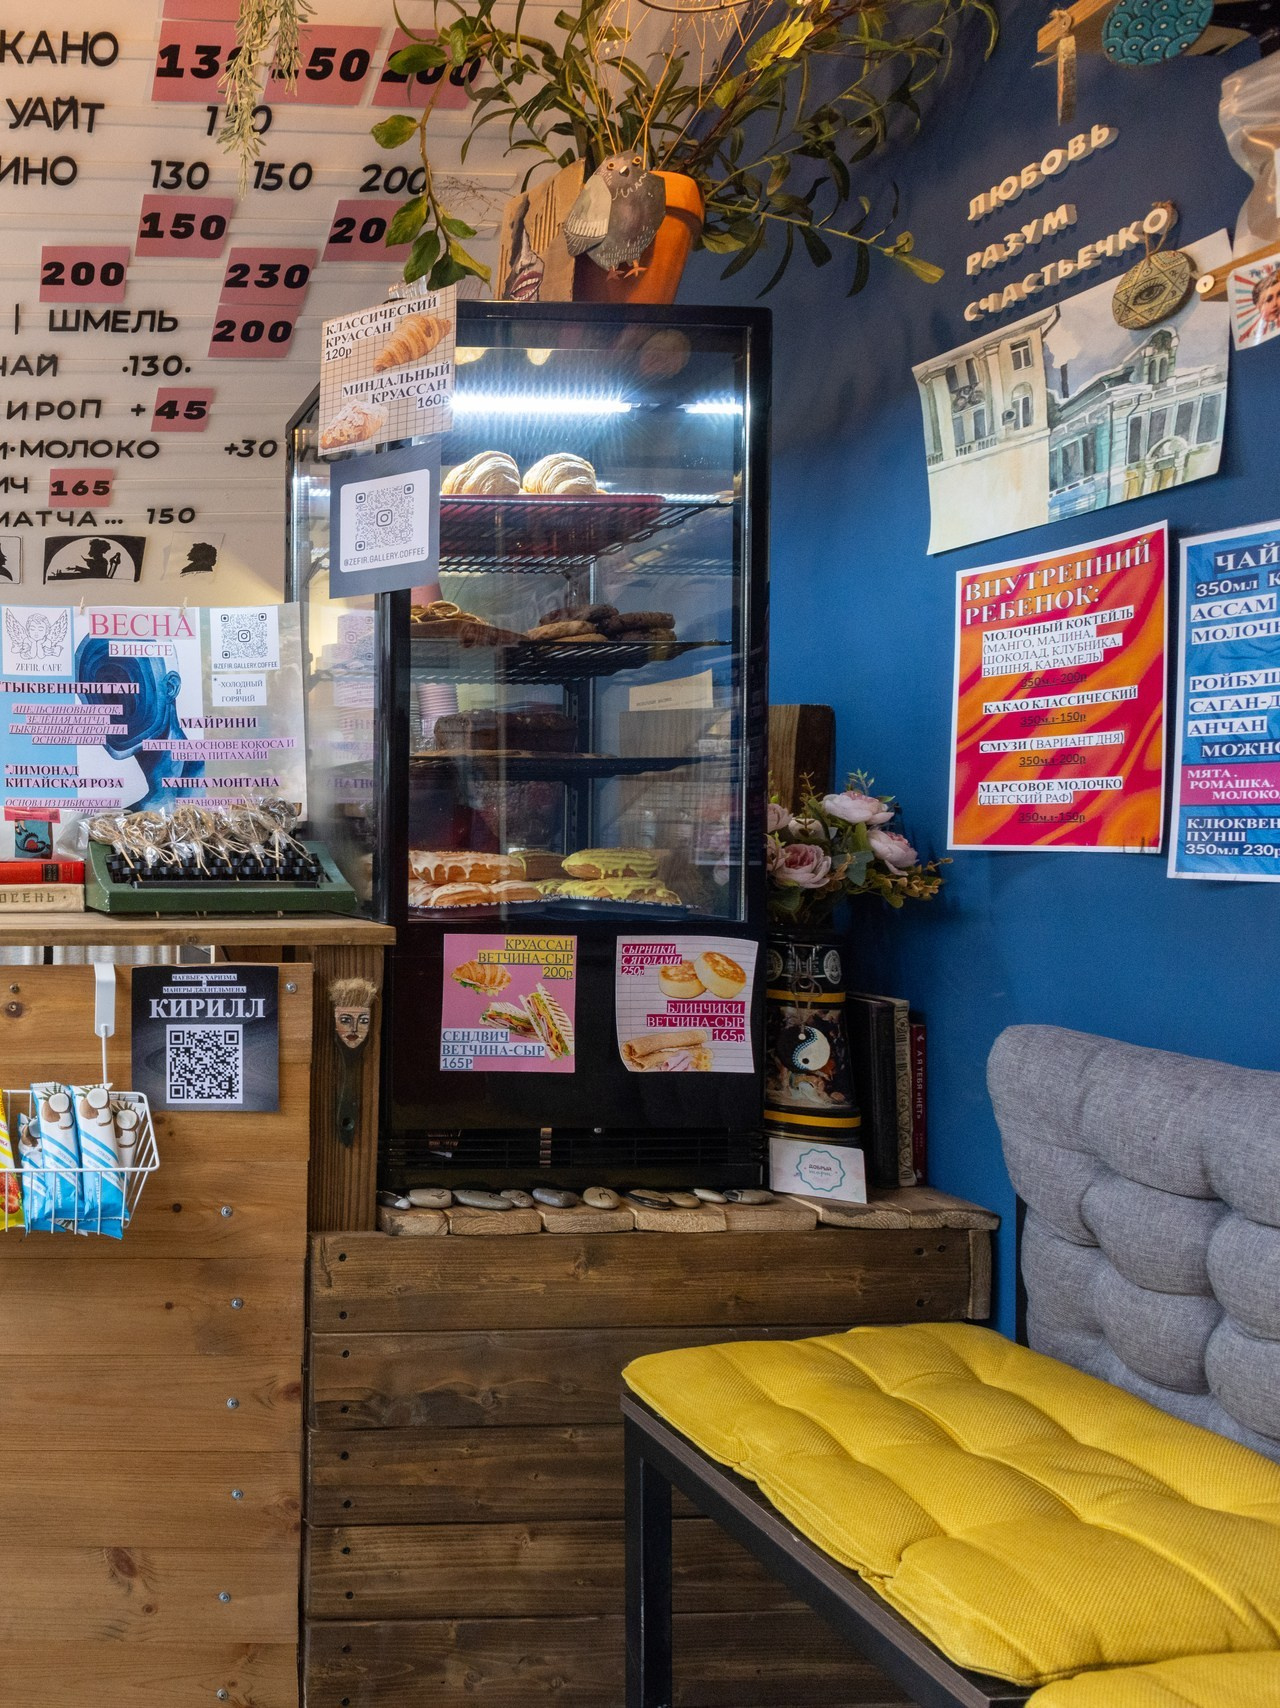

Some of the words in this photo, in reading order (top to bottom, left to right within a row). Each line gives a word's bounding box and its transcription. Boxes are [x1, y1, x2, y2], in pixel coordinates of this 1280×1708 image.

[5, 95, 105, 133] УАЙТ
[207, 105, 273, 136] 10
[150, 160, 209, 191] 130
[253, 161, 313, 192] 150
[362, 164, 427, 195] 200
[967, 124, 1118, 221] ЛЮБОВЬ
[139, 212, 227, 241] 150
[966, 203, 1077, 275] РАЗУМ
[964, 206, 1177, 322] СЧАСТЬЕЧКО
[42, 261, 124, 287] 200
[225, 263, 310, 290] 230
[326, 295, 438, 336] КЛАССИЧЕСКИЙ
[48, 309, 179, 333] ШМЕЛЬ
[211, 319, 293, 344] 200
[326, 321, 391, 349] КРУАССАН
[325, 346, 352, 362] 120р
[342, 362, 450, 398] МИНДАЛЬНЫЙ
[371, 379, 447, 404] КРУАССАН
[224, 440, 279, 459] +30
[50, 479, 113, 497] 165
[146, 507, 197, 525] 150
[343, 547, 425, 567] @ZEFIR.GALLERY.COFFEE
[1215, 542, 1280, 572] ЧАЙ
[965, 538, 1151, 602] ВНУТРЕННИЙ
[1196, 579, 1259, 598] 350мл
[966, 584, 1100, 626] РЕБЕНОК:
[1192, 597, 1275, 621] АССАМ
[91, 613, 195, 637] ВЕСНА
[983, 619, 1064, 643] МОЛОЧНЫЙ
[1066, 606, 1135, 630] КОКТЕЙЛЬ
[109, 643, 119, 656] В
[122, 643, 173, 657] ИНСТЕ
[1035, 650, 1103, 672] КАРАМЕЛЬ)
[221, 695, 256, 703] ГОРЯЧИЙ
[984, 700, 1029, 714] КАКАО
[1032, 686, 1137, 709] КЛАССИЧЕСКИЙ
[75, 725, 107, 735] СИРОП
[181, 716, 257, 729] МАЙРИНИ
[1189, 718, 1265, 736] АНЧАН
[143, 741, 177, 751] ЛАТТЕ
[178, 741, 193, 750] НА
[195, 740, 239, 750] ОСНОВЕ
[240, 739, 283, 750] КОКОСА
[287, 739, 295, 748] И
[980, 740, 1027, 753] СМУЗИ
[1096, 731, 1125, 746] ДНЯ)
[172, 751, 206, 761] ЦВЕТА
[208, 749, 268, 760] ПИТАХАЙИ
[5, 776, 87, 788] КИТАЙСКАЯ
[90, 778, 124, 788] РОЗА
[162, 778, 208, 788] ХАННА
[211, 778, 280, 788] МОНТАНА
[980, 782, 1055, 793] МАРСОВОЕ
[1057, 778, 1123, 791] МОЛОЧКО
[1190, 779, 1274, 789] РОМАШКА.
[979, 792, 1043, 806] (ДЕТСКИЙ
[1045, 791, 1073, 804] РАФ)
[1186, 831, 1246, 842] ПУНШ
[1185, 844, 1238, 855] 350мл
[505, 939, 573, 951] КРУАССАН
[622, 945, 676, 954] СЫРНИКИ
[478, 952, 573, 964] ВЕТЧИНА-СЫР
[622, 956, 631, 965] С
[630, 956, 682, 966] ЯГОДАМИ
[543, 967, 573, 981] 200р
[622, 966, 645, 977] 250р
[149, 998, 266, 1019] КИРИЛЛ
[667, 1002, 741, 1014] БЛИНЧИКИ
[647, 1016, 745, 1028] ВЕТЧИНА-СЫР
[442, 1030, 509, 1043] СЕНДВИЧ
[713, 1030, 745, 1043] 165р
[442, 1044, 545, 1056] ВЕТЧИНА-СЫР
[916, 1067, 924, 1090] ТЕБЯ
